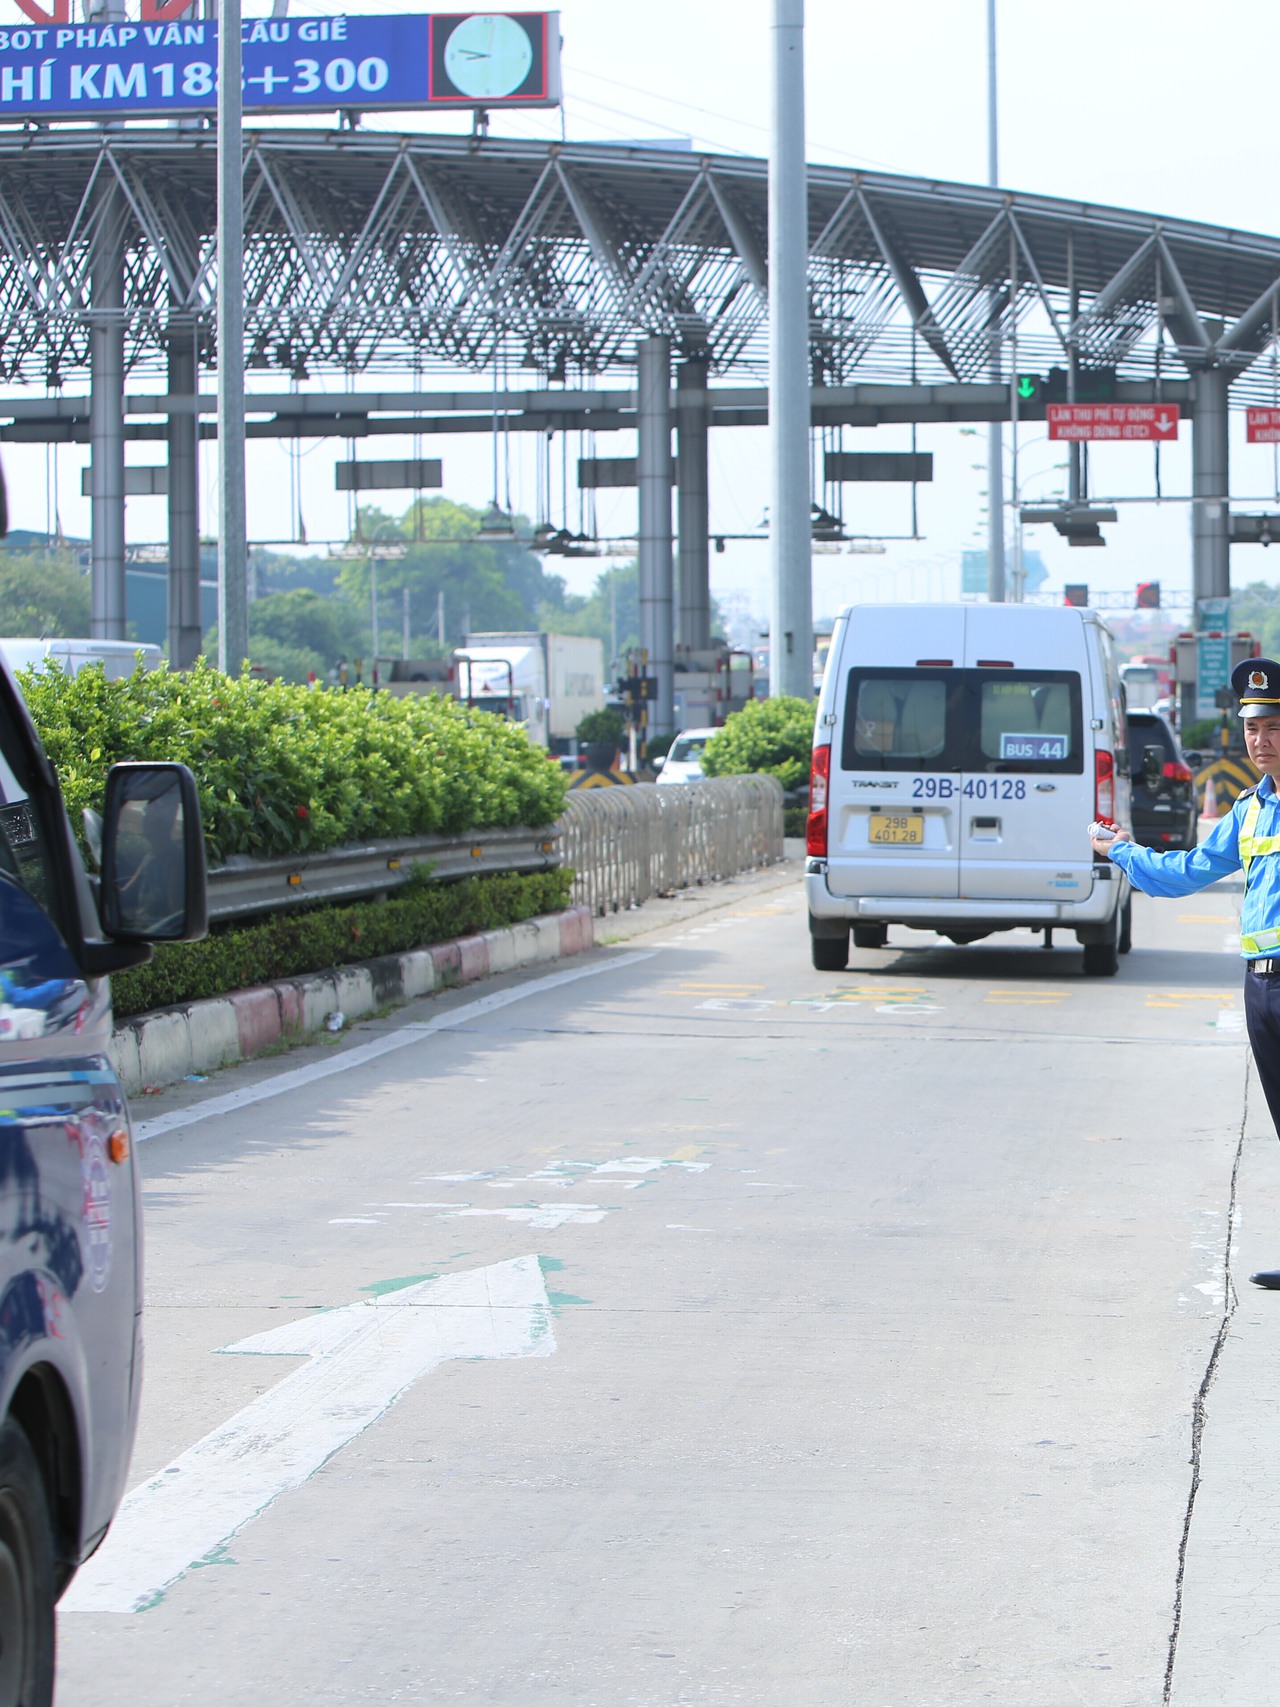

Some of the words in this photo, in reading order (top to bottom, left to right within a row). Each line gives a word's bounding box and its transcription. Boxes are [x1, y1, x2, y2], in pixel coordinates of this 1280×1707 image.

[56, 24, 138, 49] PHÁP
[144, 22, 205, 46] VÂN
[1072, 408, 1092, 421] THU
[1006, 743, 1033, 757] BUS
[1039, 742, 1062, 758] 44
[912, 778, 1026, 800] 29B-40128
[885, 817, 908, 829] 29B
